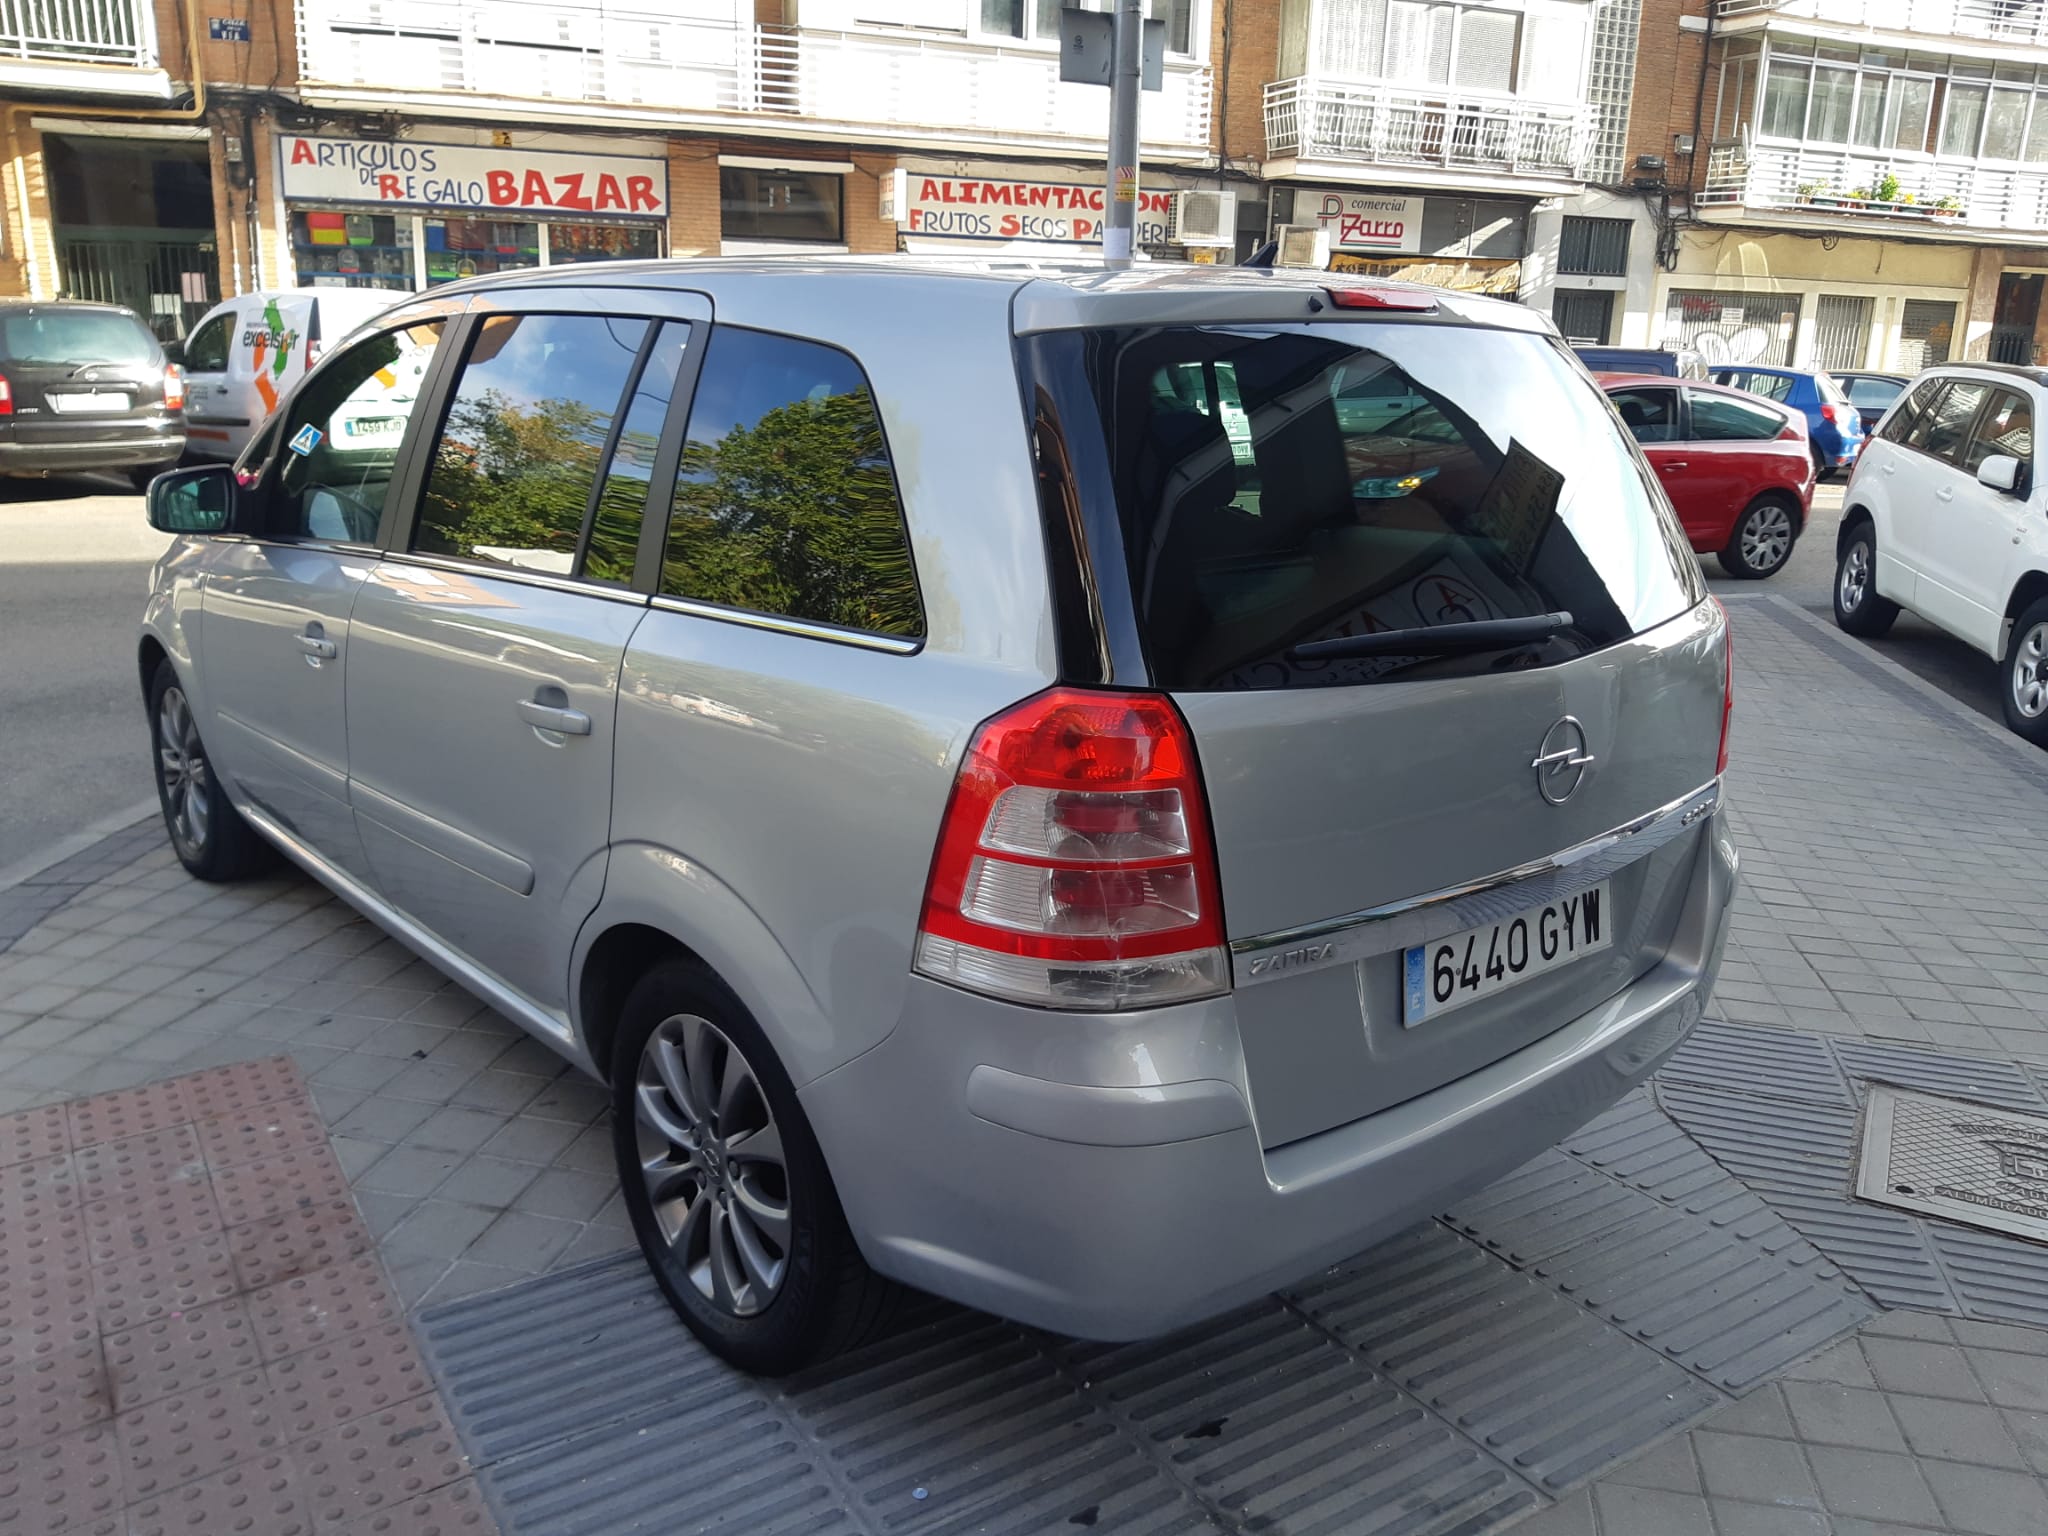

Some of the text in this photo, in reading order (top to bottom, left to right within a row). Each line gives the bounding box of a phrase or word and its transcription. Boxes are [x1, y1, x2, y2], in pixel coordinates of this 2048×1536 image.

[291, 138, 437, 172] ARTICULOS
[360, 167, 380, 185] DE
[486, 169, 662, 212] BAZAR
[1351, 199, 1407, 212] comercial
[910, 208, 991, 234] FRUTOS
[999, 214, 1067, 239] SECOS
[1249, 943, 1333, 975] ZAFIRA
[1433, 889, 1600, 1002] 6440 GYW
